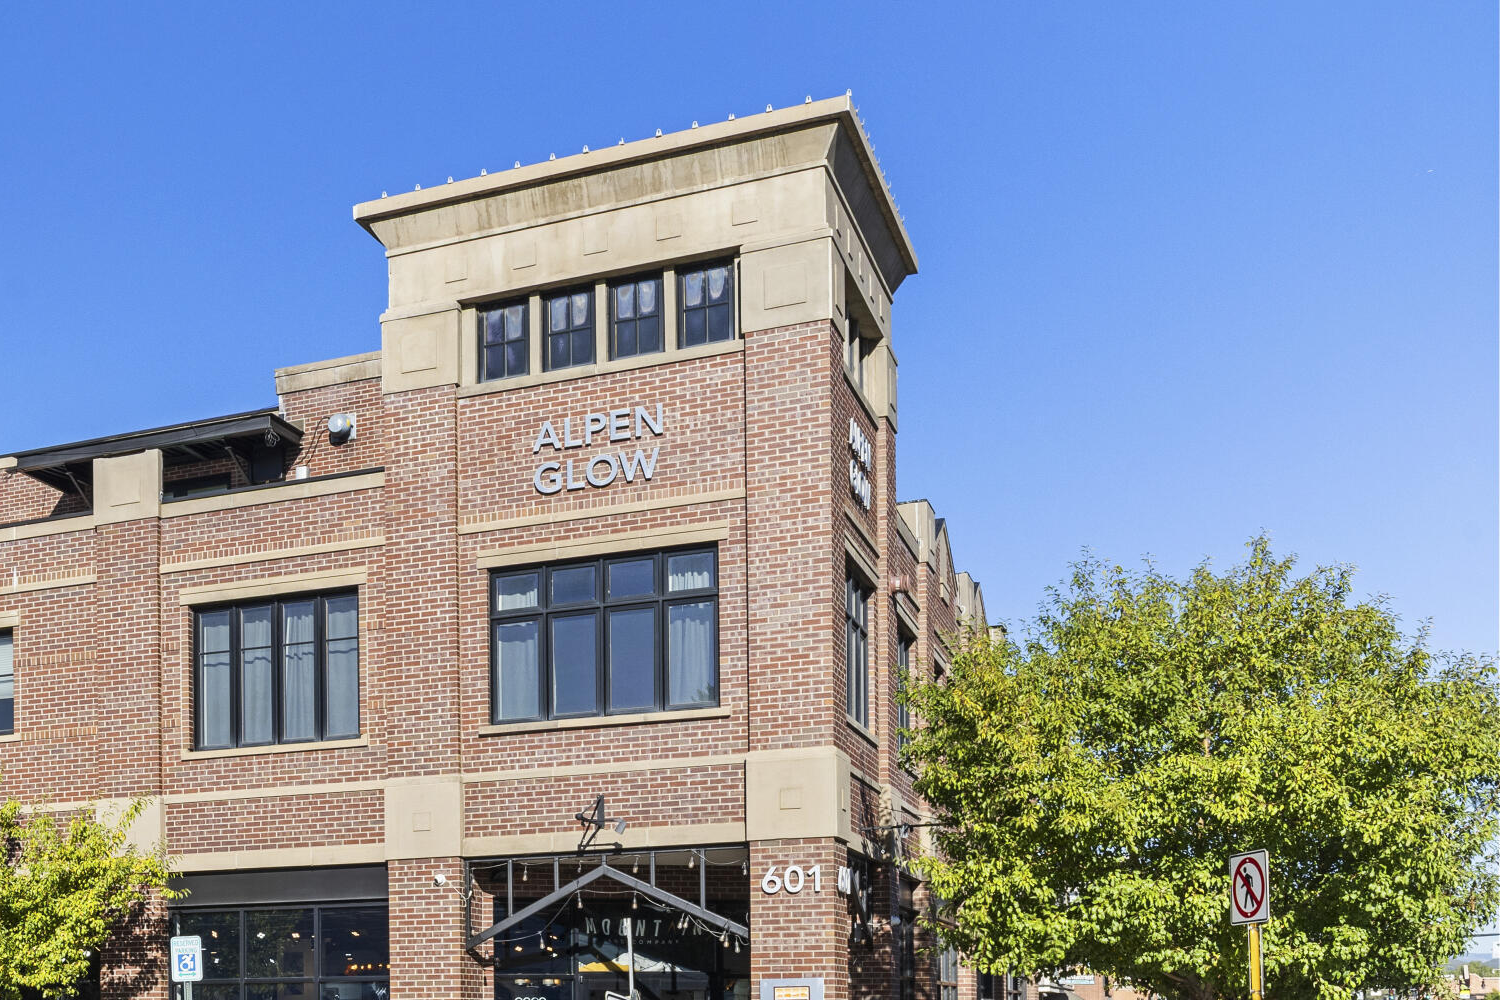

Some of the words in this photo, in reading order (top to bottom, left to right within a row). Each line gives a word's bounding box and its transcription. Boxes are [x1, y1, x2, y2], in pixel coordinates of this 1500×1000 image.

[533, 403, 664, 454] ALPEN
[534, 447, 660, 496] GLOW
[761, 865, 821, 895] 601
